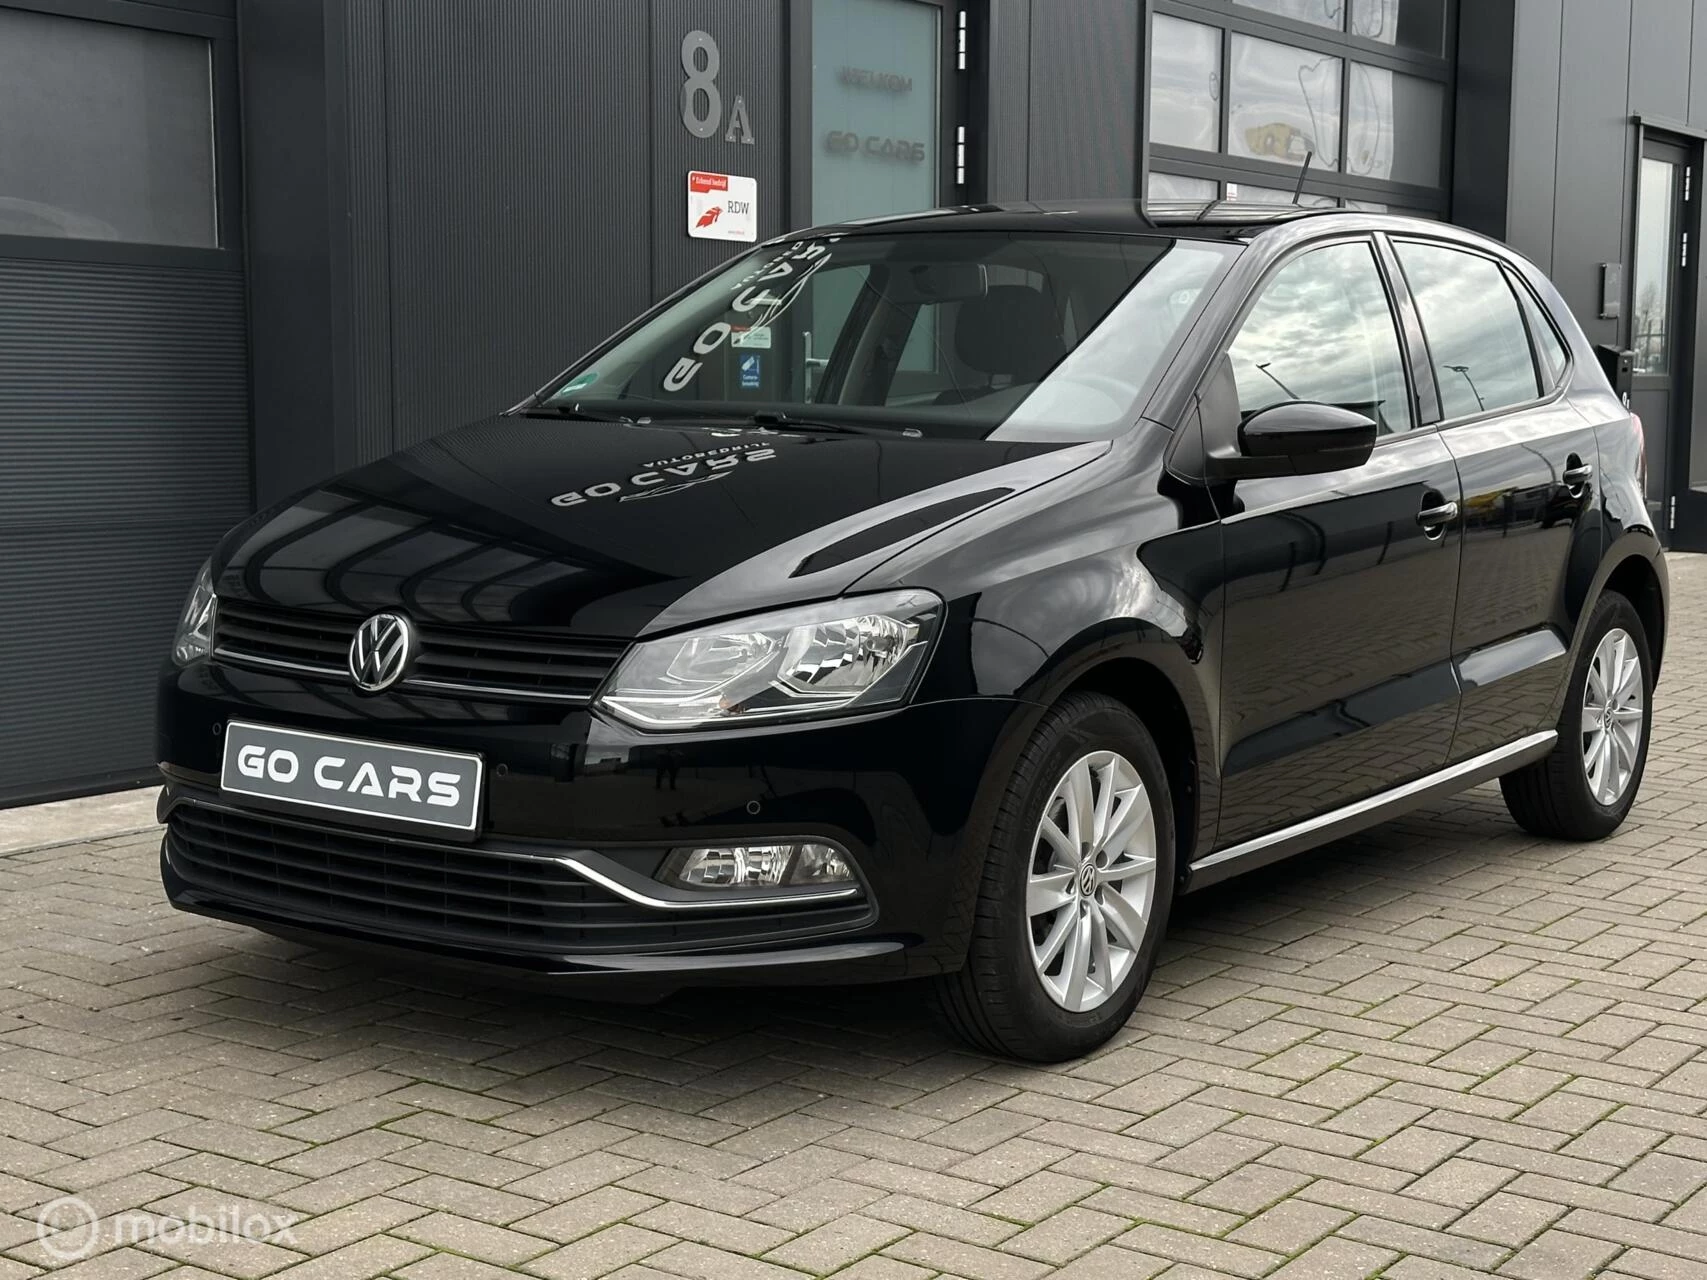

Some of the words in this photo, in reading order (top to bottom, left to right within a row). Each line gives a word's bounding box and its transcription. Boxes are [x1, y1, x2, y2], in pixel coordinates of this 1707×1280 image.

[837, 65, 912, 92] WELKOM
[825, 130, 859, 154] GO
[865, 135, 925, 162] CARS
[727, 200, 750, 215] RDW
[237, 744, 300, 784] GO
[313, 755, 461, 808] CARS
